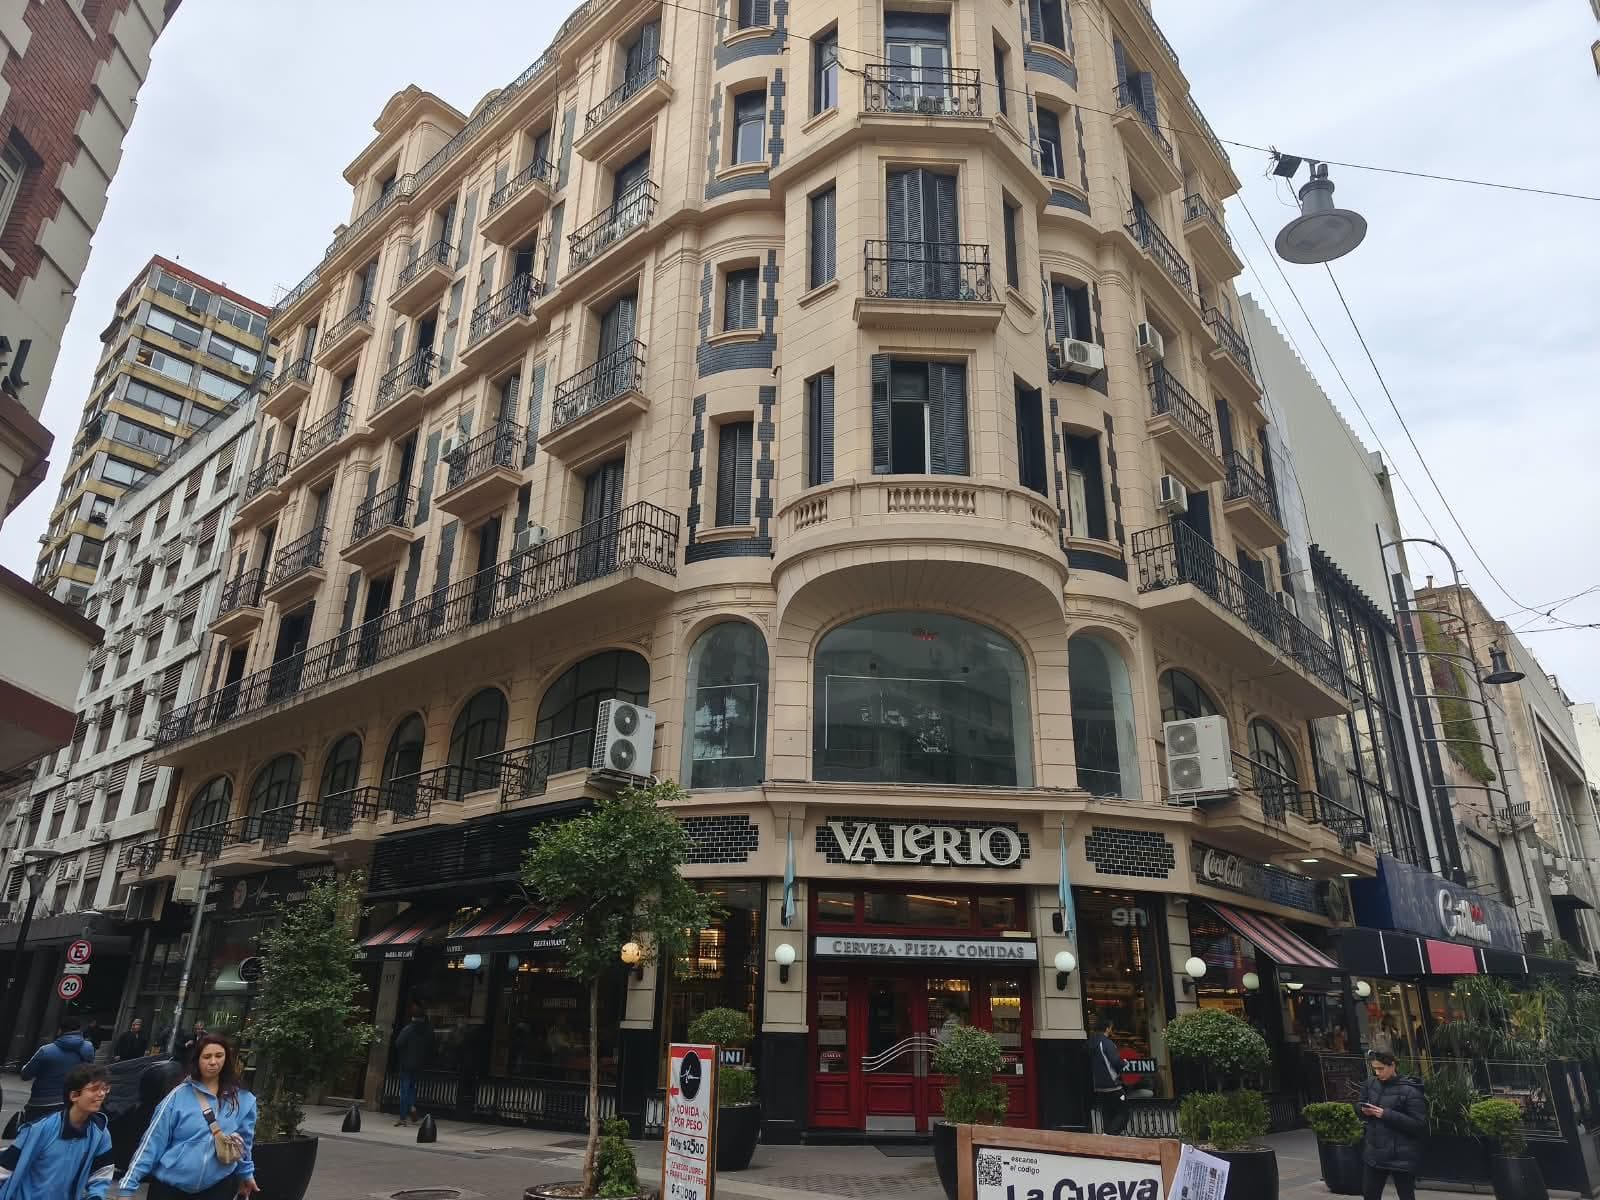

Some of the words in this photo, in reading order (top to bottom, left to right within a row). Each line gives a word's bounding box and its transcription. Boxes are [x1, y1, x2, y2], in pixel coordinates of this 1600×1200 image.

[832, 940, 899, 956] CERVEZA
[904, 942, 948, 957] PIZZA
[956, 944, 1025, 959] COMIDAS
[63, 981, 78, 992] 20
[685, 1119, 703, 1131] PESO
